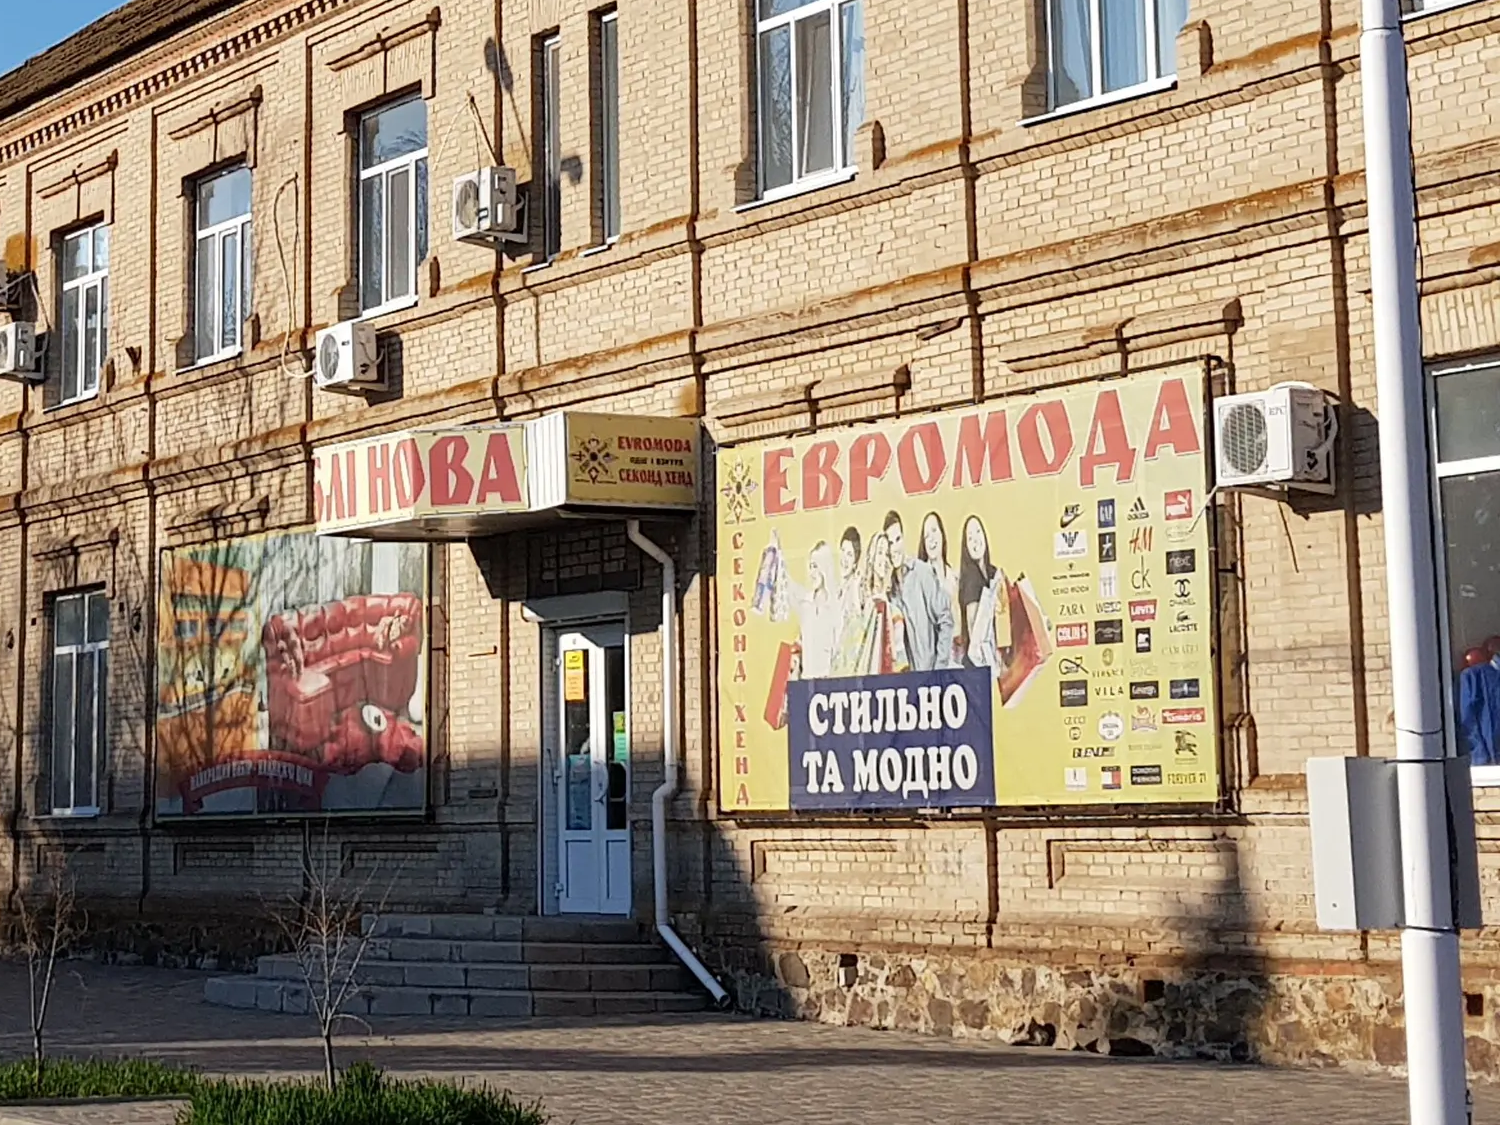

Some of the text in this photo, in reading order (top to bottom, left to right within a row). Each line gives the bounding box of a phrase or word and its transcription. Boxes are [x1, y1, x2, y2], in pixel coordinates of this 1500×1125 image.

[617, 436, 692, 453] EVROMODA
[763, 380, 1200, 516] ЕВРОМОДА
[618, 468, 663, 487] СЕКОНД
[664, 470, 694, 488] ХЕНД
[731, 531, 748, 683] СЕКОНД
[1059, 603, 1086, 616] ZARA
[808, 682, 967, 736] СТИЛЬНО
[1094, 685, 1125, 697] VILA
[734, 704, 749, 806] ХЕНД
[802, 743, 978, 800] ТА МОДНО
